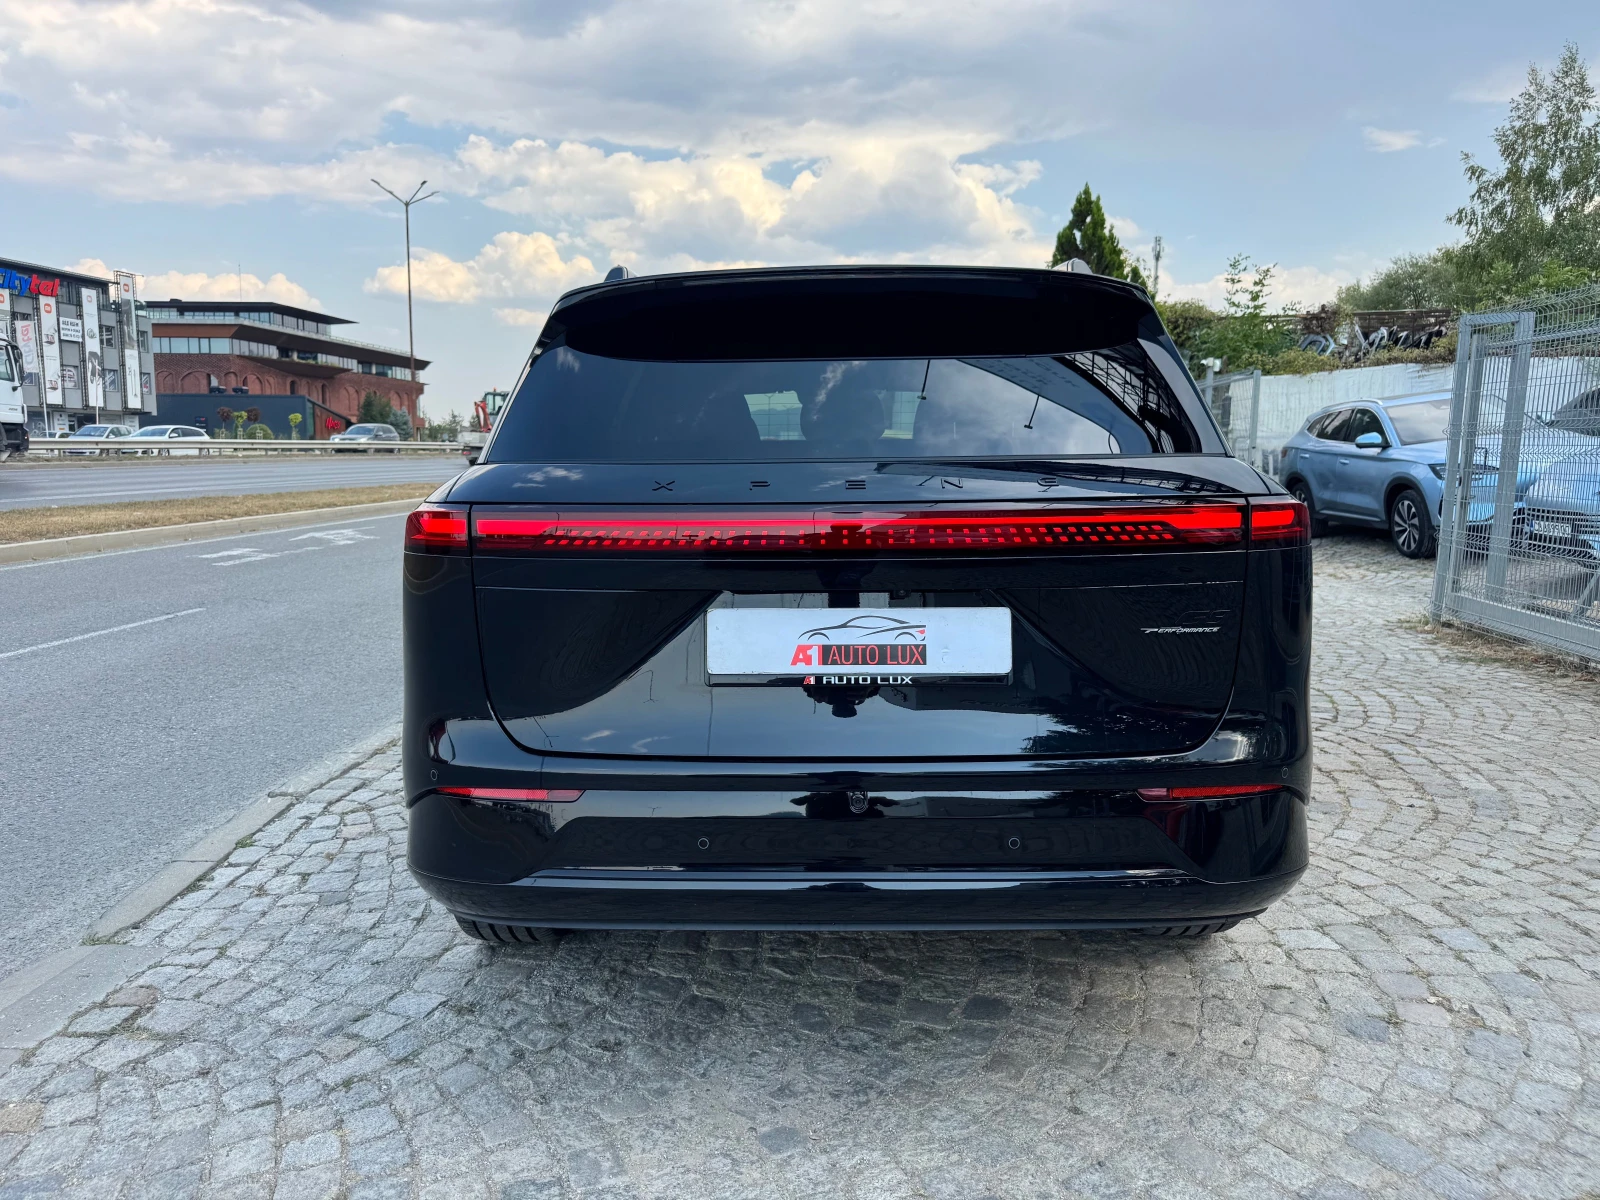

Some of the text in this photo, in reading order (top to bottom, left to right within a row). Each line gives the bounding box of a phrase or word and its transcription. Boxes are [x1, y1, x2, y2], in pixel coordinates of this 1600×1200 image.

[652, 478, 1060, 491] XPENG
[791, 644, 924, 666] A1 AUTO LUX
[803, 675, 913, 685] A1 AUTO LUX
